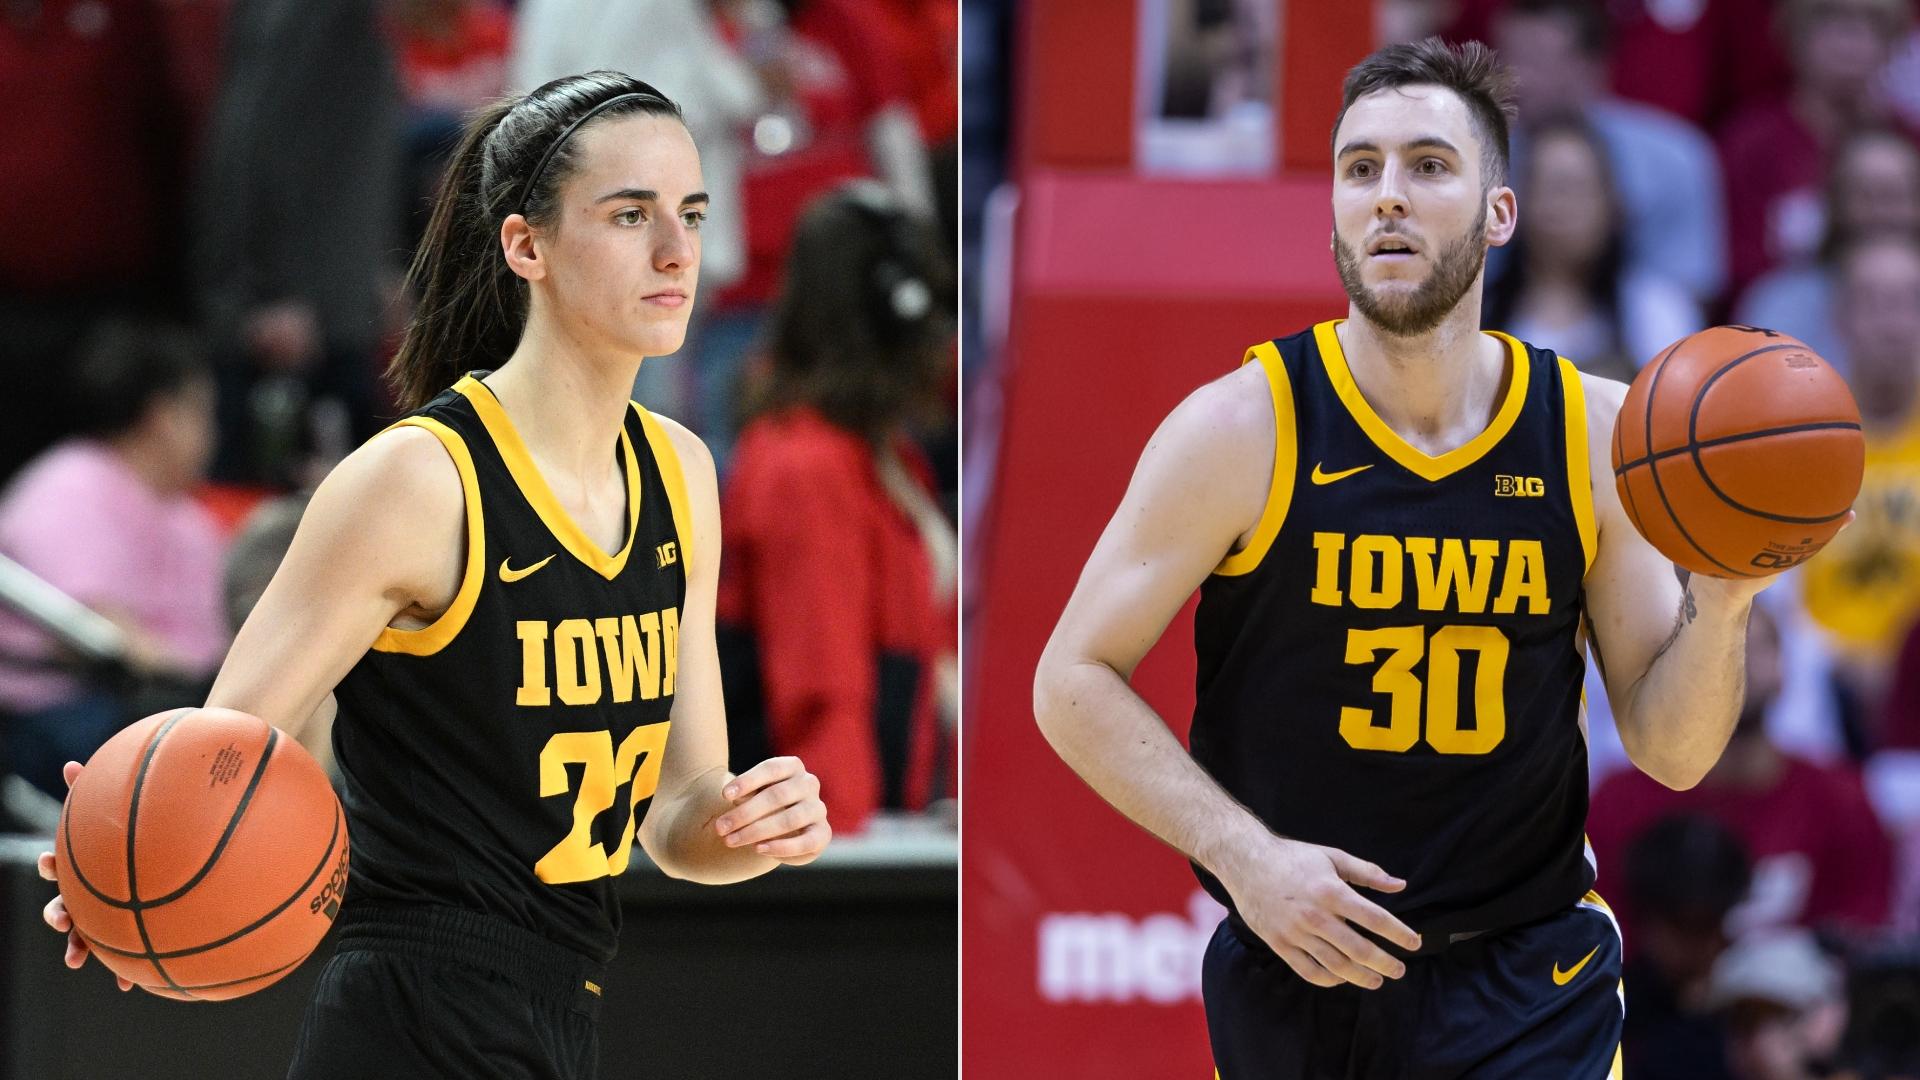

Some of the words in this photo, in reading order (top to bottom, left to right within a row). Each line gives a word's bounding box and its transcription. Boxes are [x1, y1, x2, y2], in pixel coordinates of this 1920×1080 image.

[1311, 532, 1551, 615] IOWA
[1338, 625, 1510, 754] 30
[534, 721, 671, 884] 22
